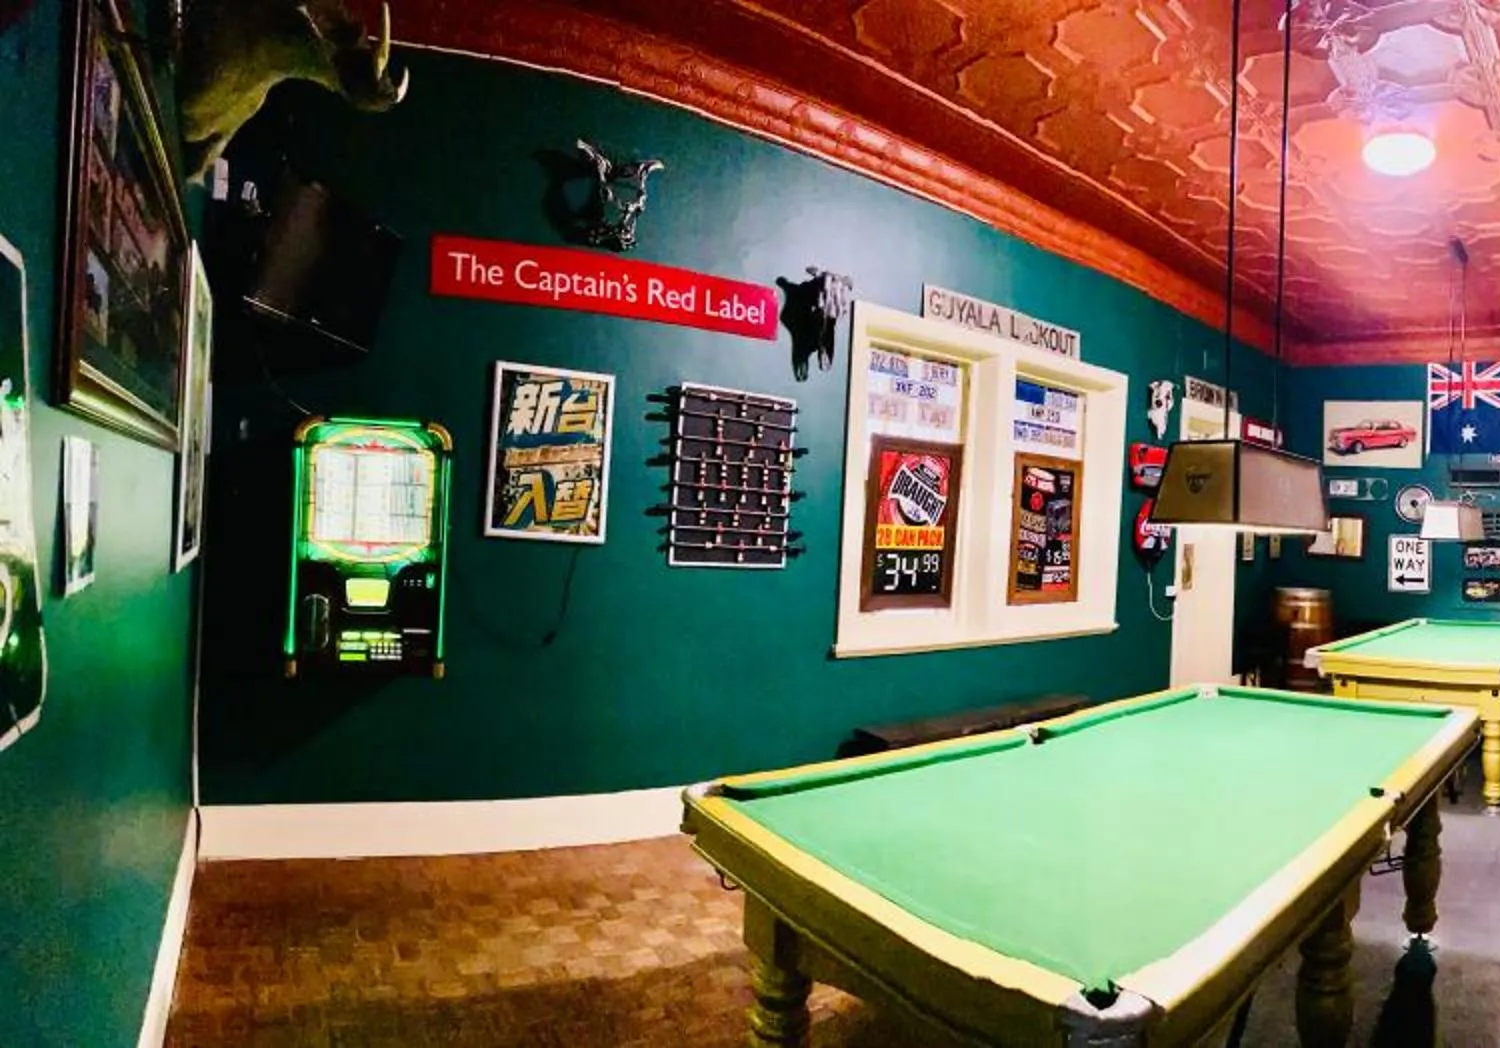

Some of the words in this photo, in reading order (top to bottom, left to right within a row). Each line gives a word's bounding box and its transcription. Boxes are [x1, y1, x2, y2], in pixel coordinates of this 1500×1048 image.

[448, 251, 504, 285] The
[514, 260, 638, 303] Captain's
[647, 278, 696, 313] Red
[704, 289, 766, 325] Label
[1010, 314, 1077, 357] LOKOUT
[890, 468, 946, 523] DRAUGHT
[1393, 558, 1426, 573] WAY
[1395, 540, 1425, 555] ONE
